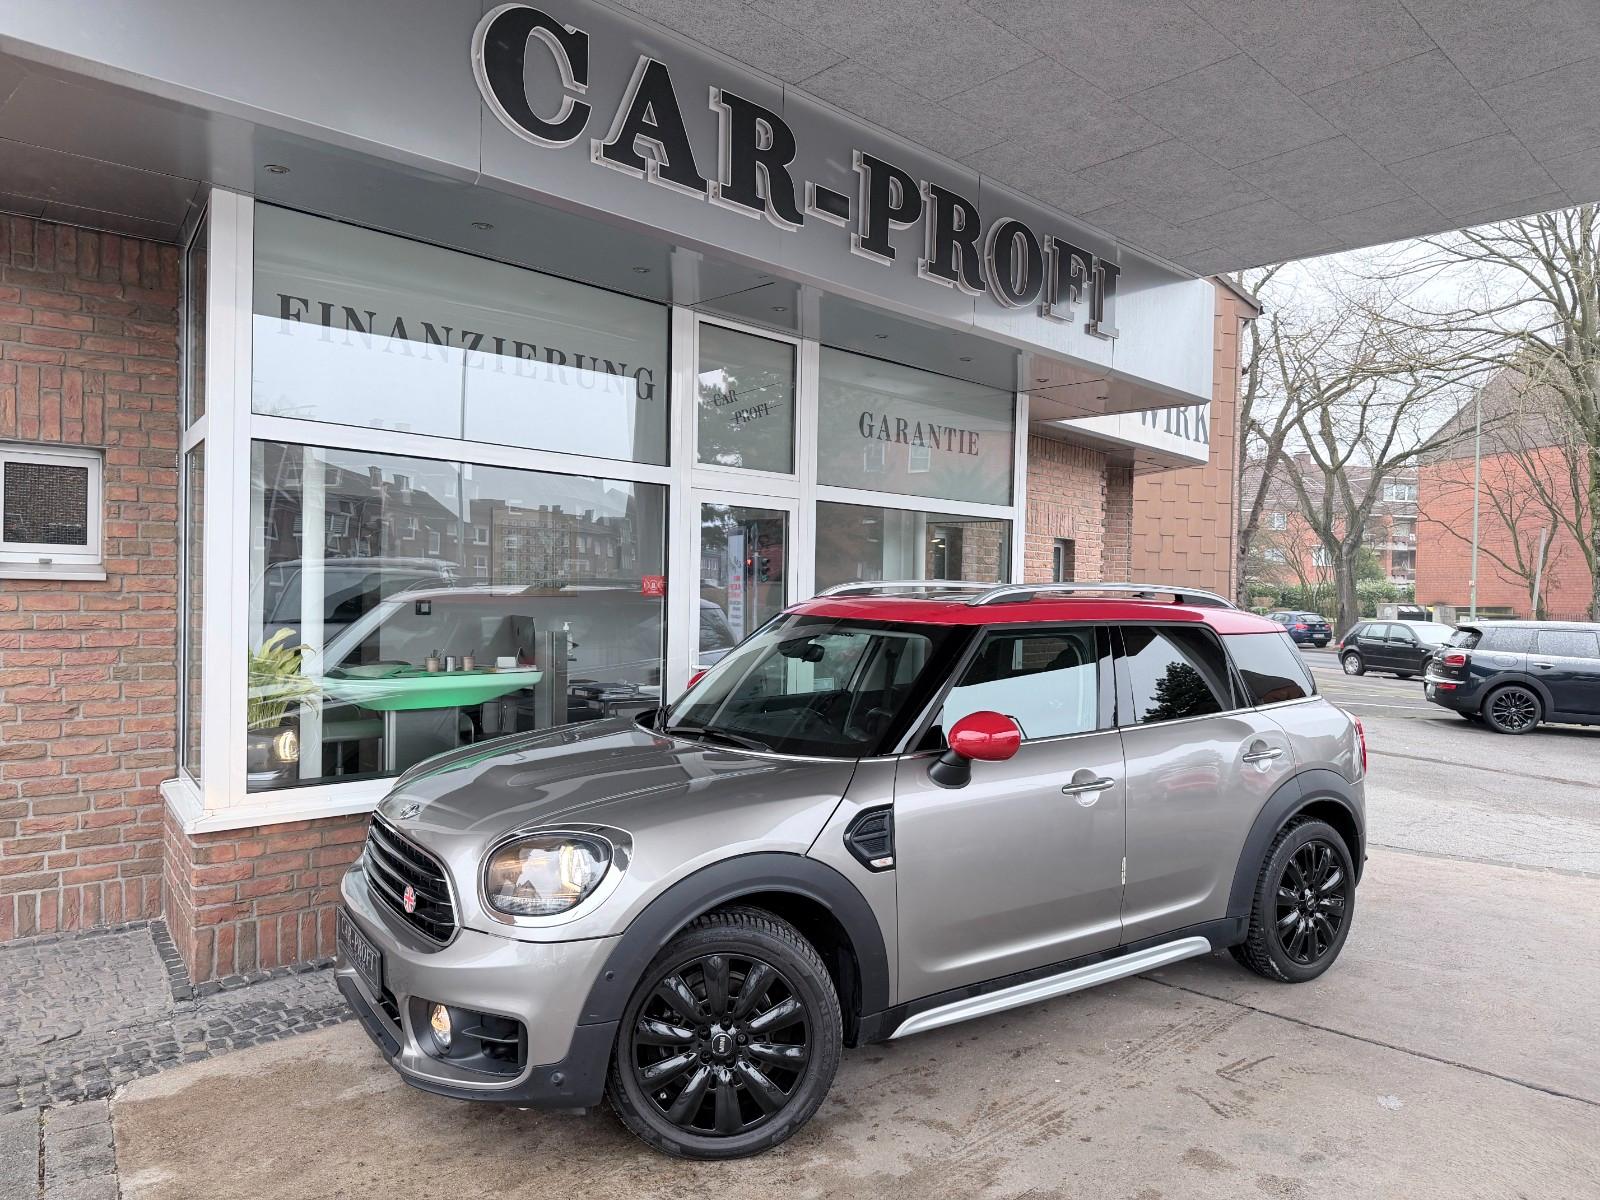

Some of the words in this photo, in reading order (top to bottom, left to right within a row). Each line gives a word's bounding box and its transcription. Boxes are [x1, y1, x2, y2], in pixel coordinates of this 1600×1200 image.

[471, 3, 1122, 340] CAR-PROFI
[276, 292, 657, 402] FINANZIERUNG
[712, 389, 737, 408] CAR
[734, 402, 769, 425] PROFI
[858, 411, 980, 456] GARANTIE
